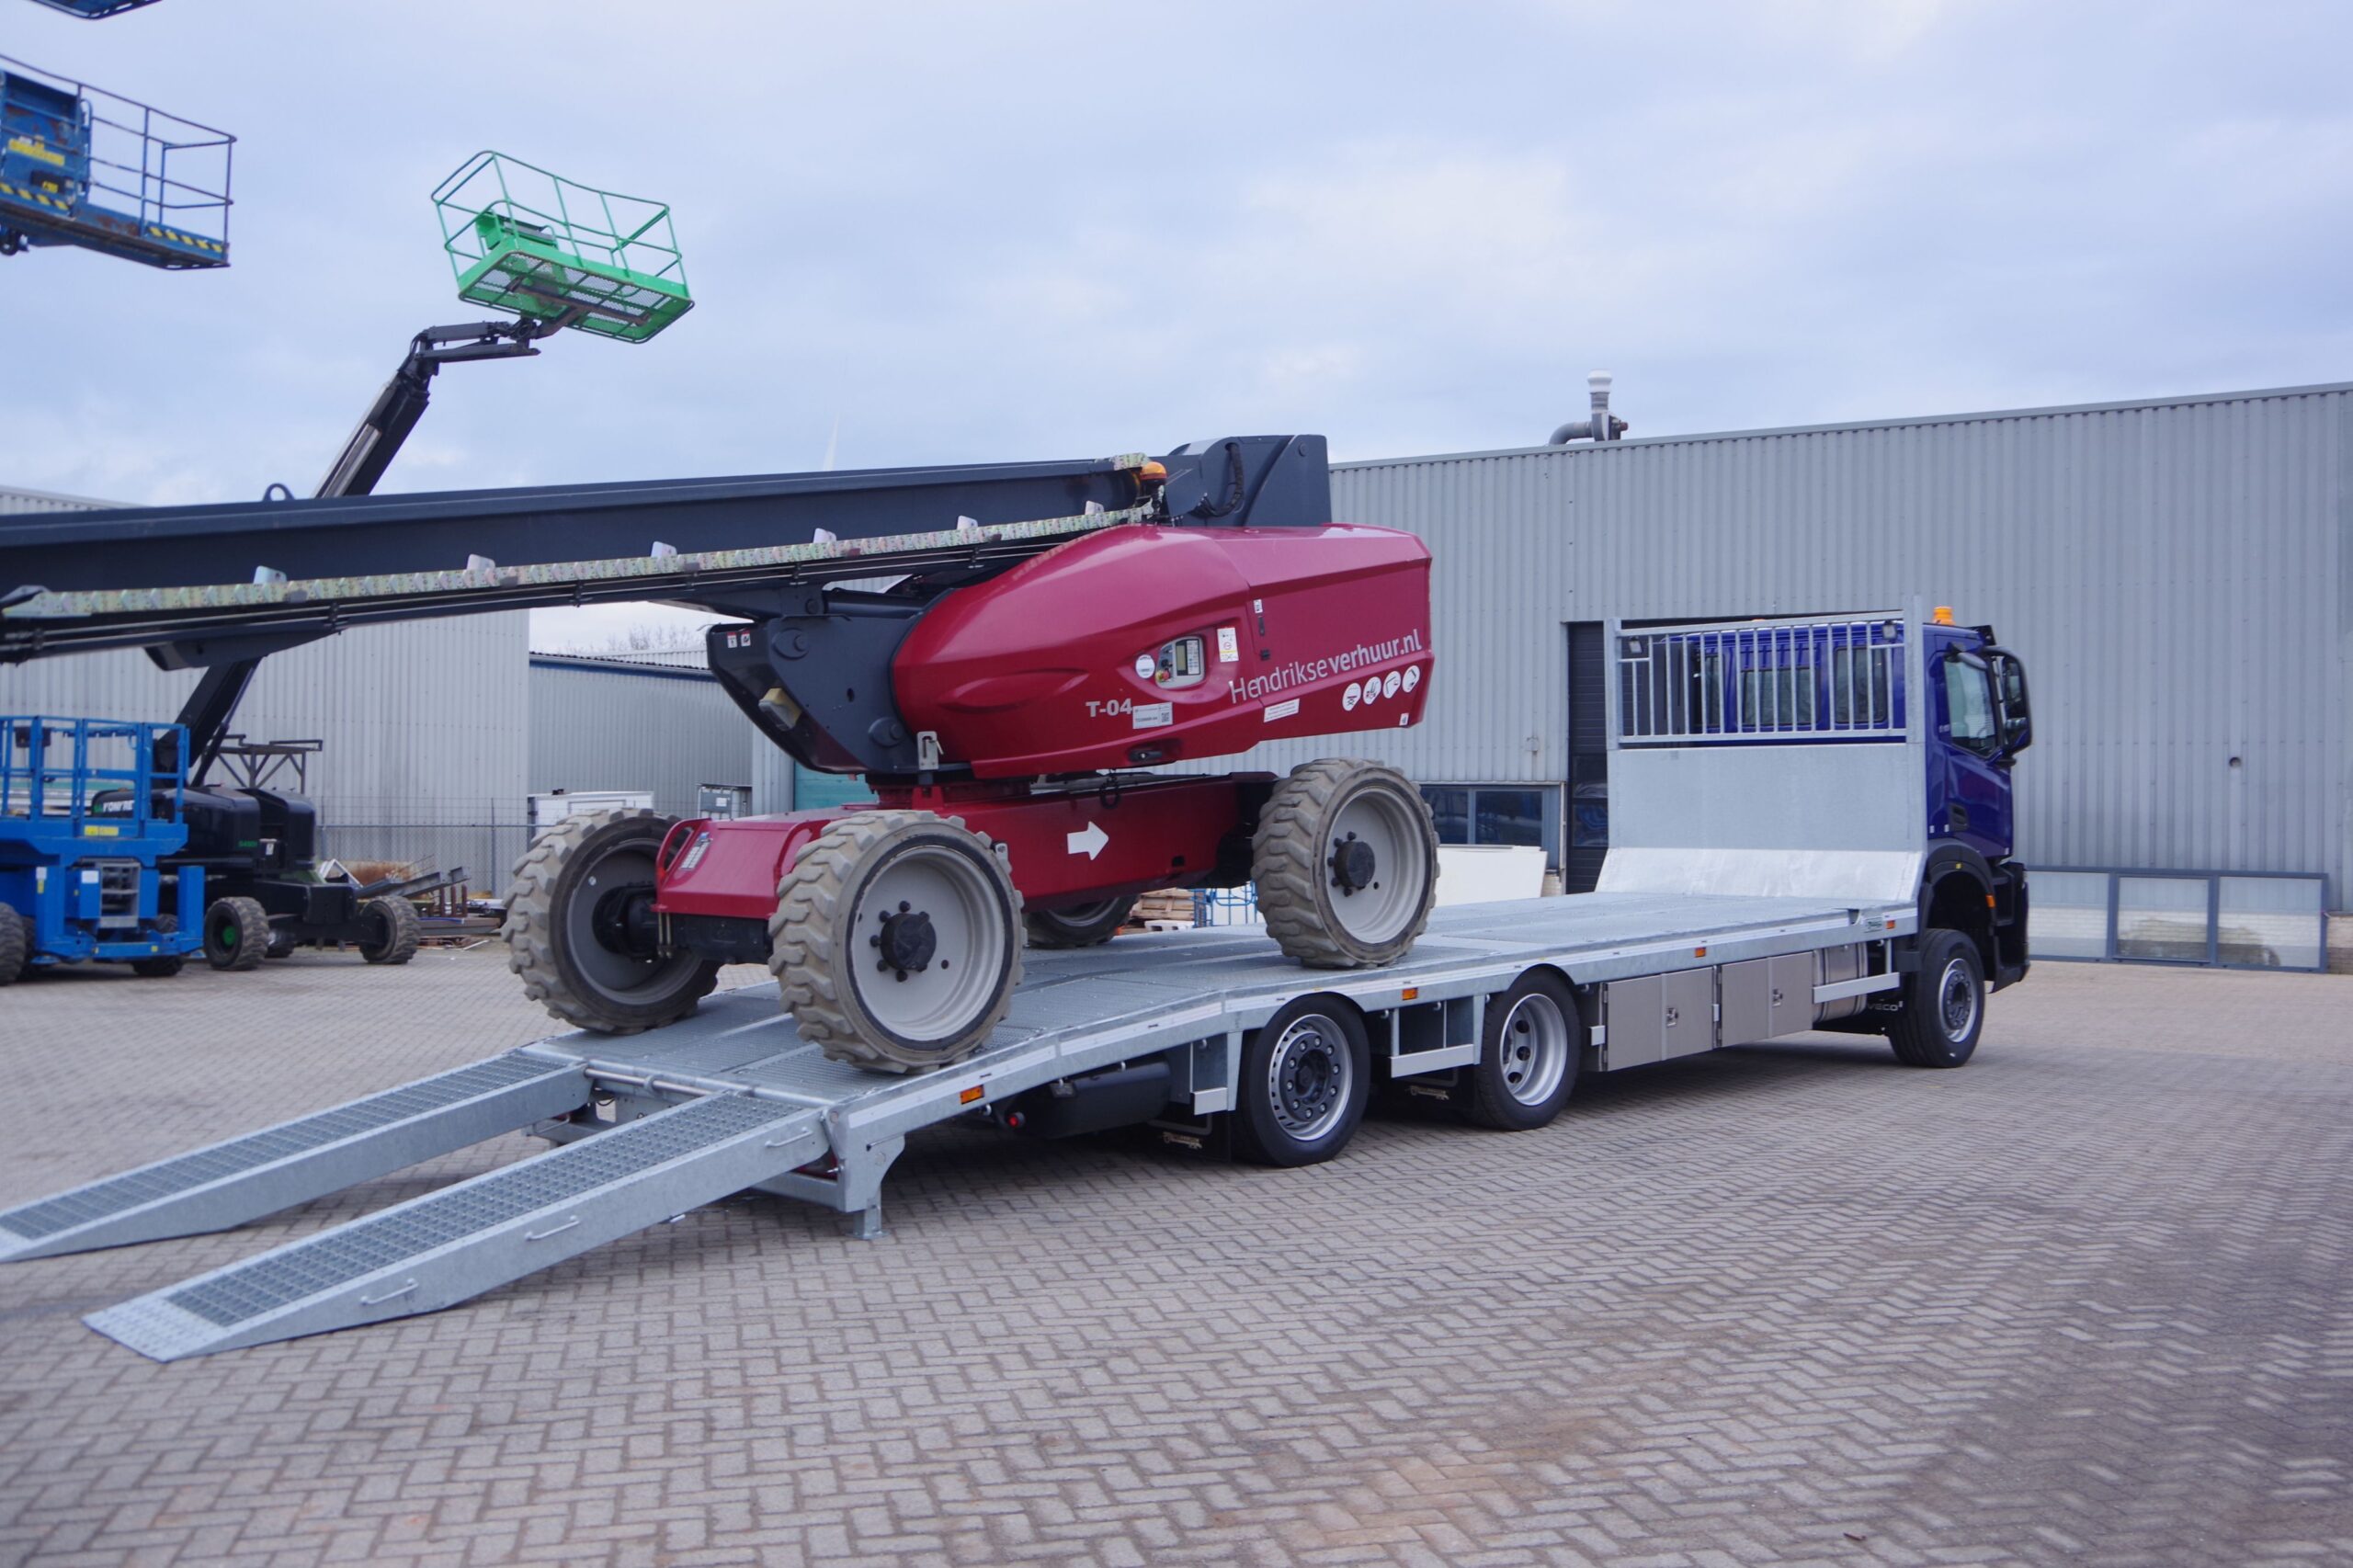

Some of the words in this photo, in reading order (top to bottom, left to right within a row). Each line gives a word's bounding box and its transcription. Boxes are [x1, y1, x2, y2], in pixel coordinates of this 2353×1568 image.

[1228, 628, 1423, 704] Hendrikseverhuur.nl
[1086, 698, 1133, 718] T-04
[1867, 1002, 1899, 1012] VECO
